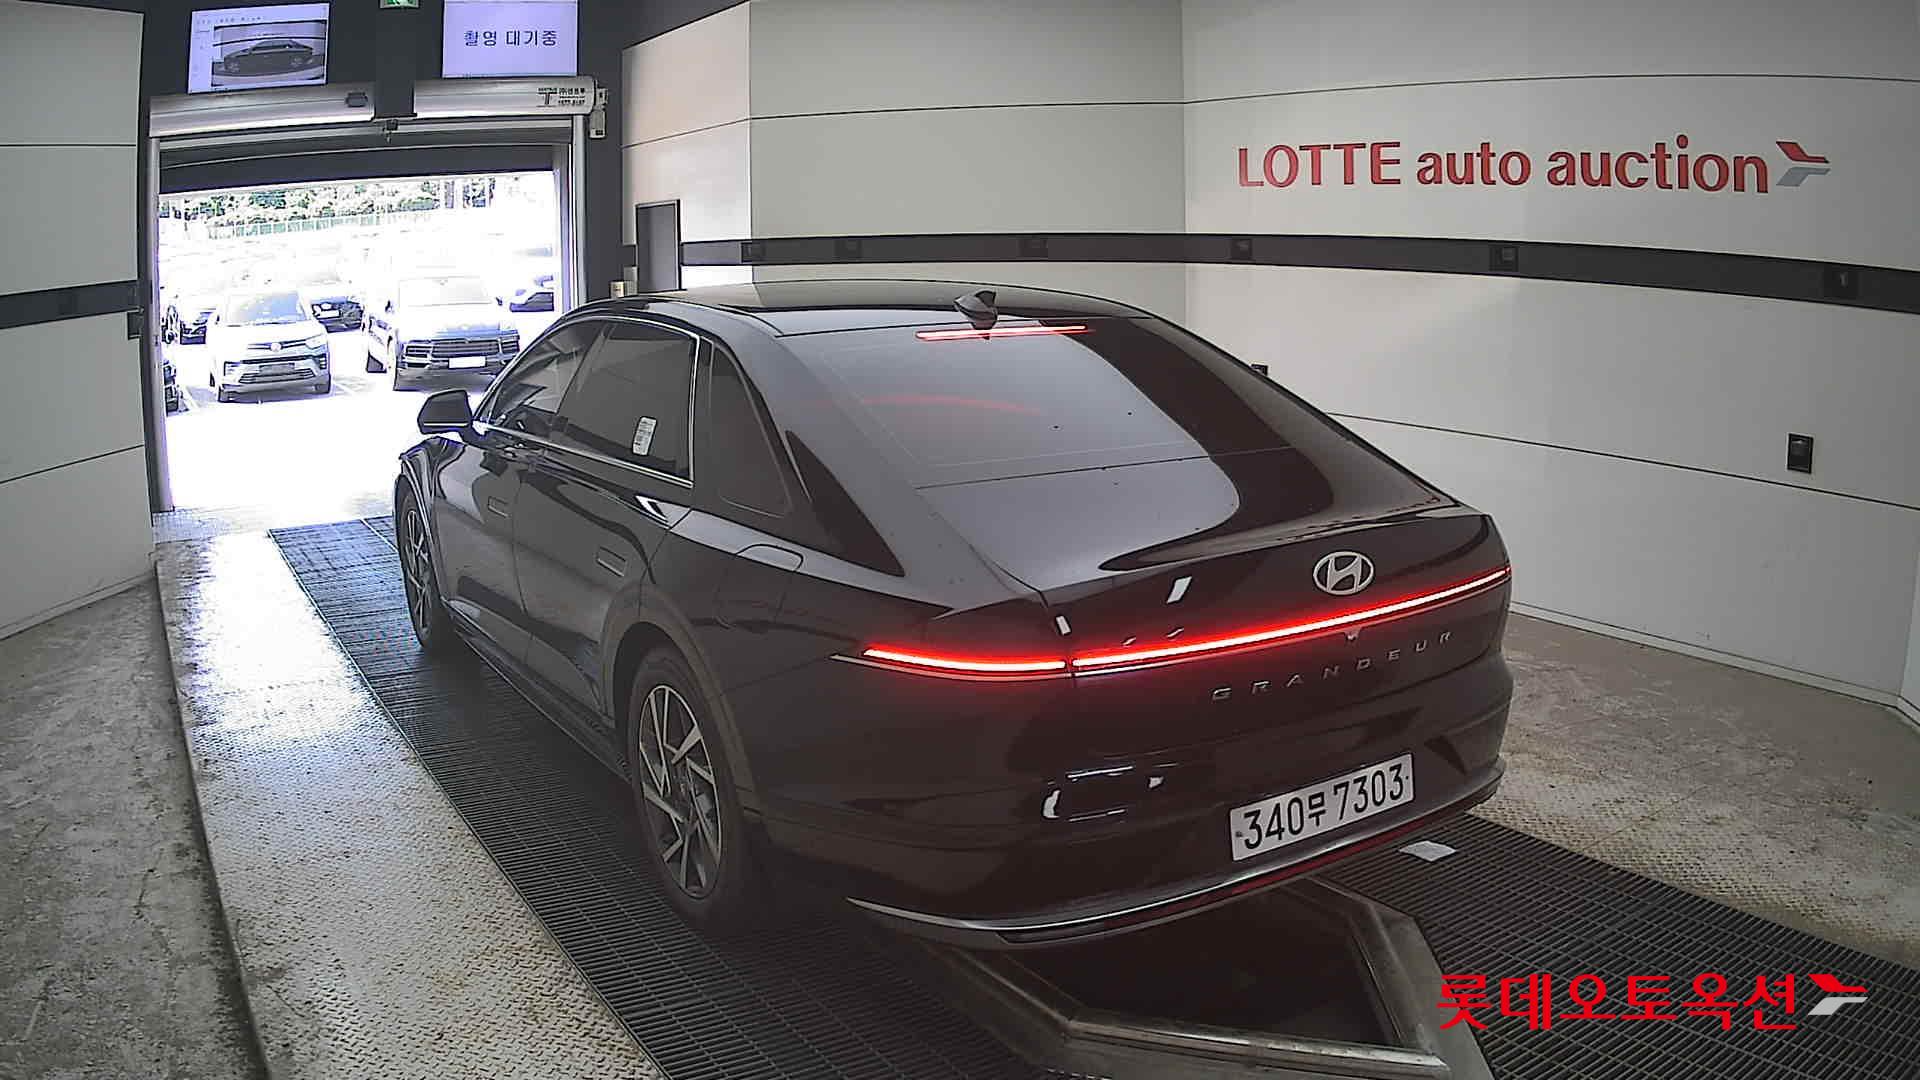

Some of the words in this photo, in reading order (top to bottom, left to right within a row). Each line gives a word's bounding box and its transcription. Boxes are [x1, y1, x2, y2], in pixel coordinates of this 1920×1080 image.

[504, 30, 557, 46] 대기중
[1238, 141, 1401, 188] LOTTE
[1416, 142, 1532, 186] auto
[1546, 134, 1769, 194] auction
[1211, 631, 1451, 700] GRANDEUR
